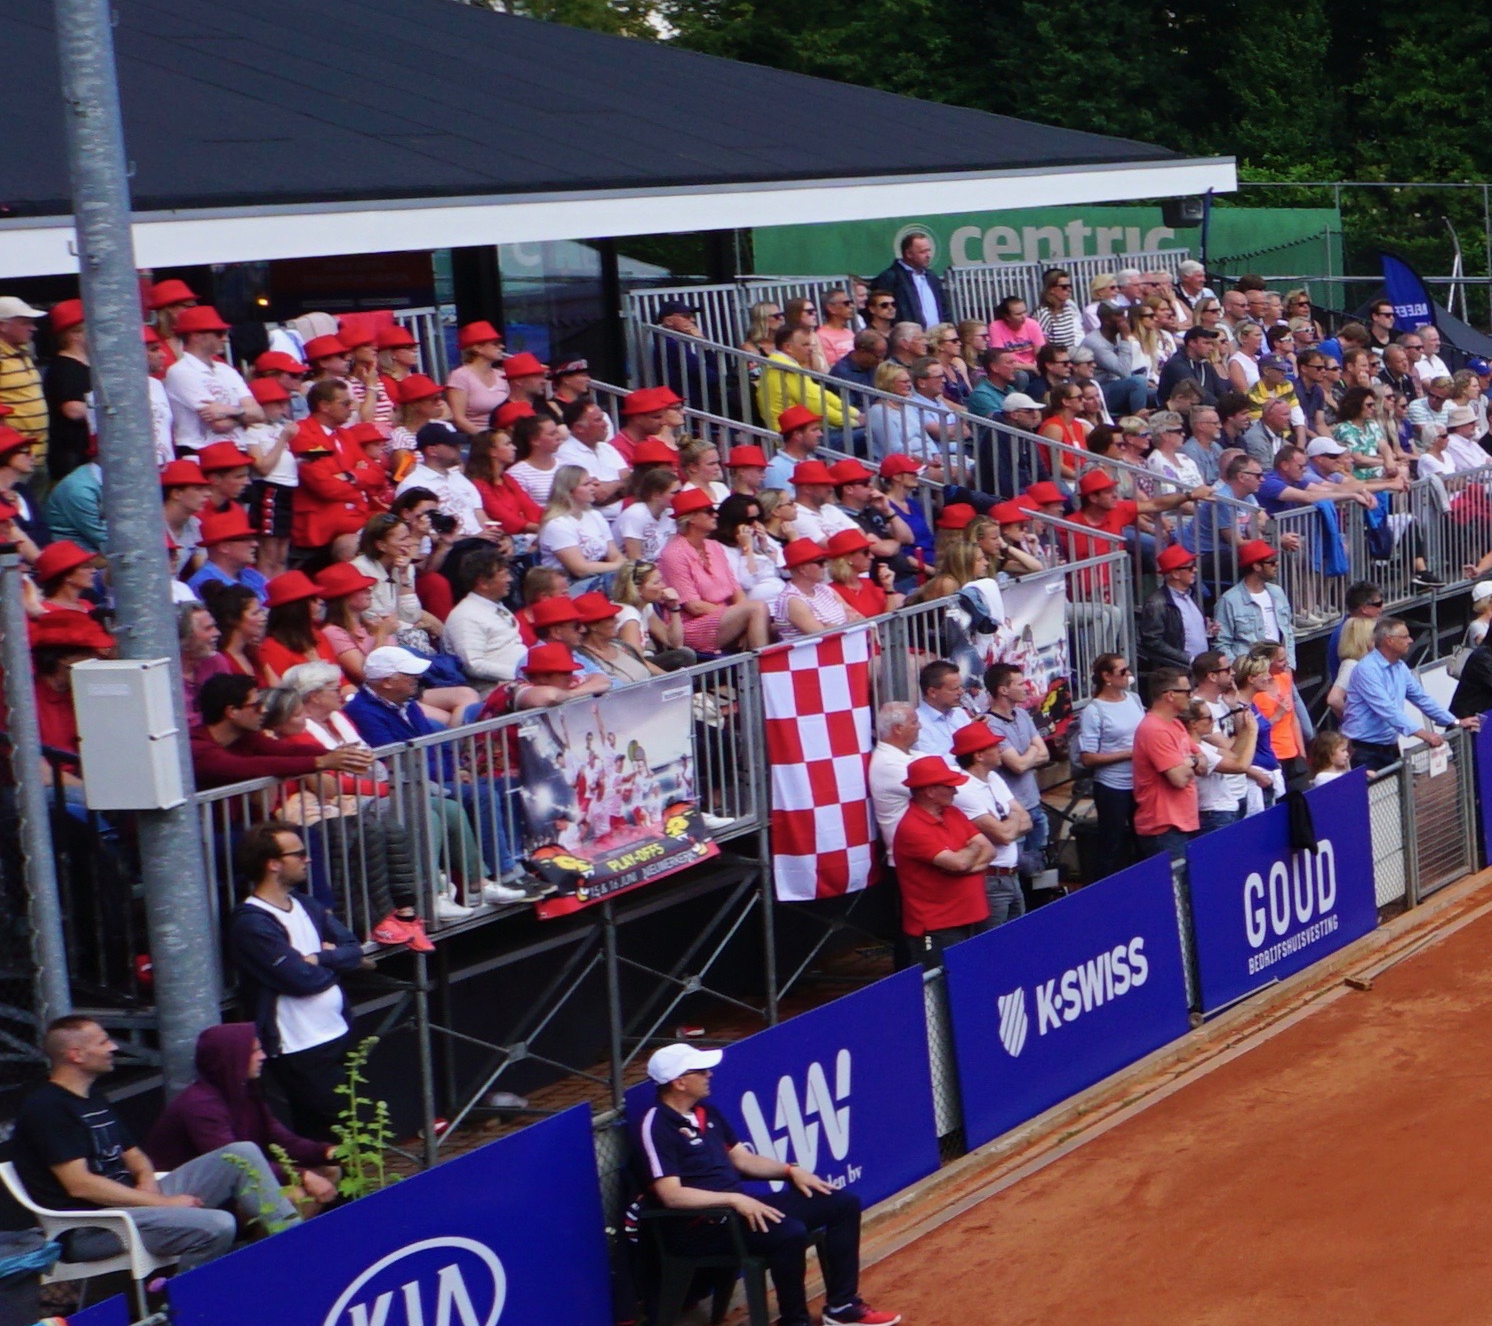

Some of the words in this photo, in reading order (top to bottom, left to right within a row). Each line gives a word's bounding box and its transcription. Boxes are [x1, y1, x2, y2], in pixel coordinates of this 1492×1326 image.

[950, 219, 1175, 270] centric
[606, 842, 666, 873] PLAY-OFFS
[1244, 838, 1337, 948] GOUD
